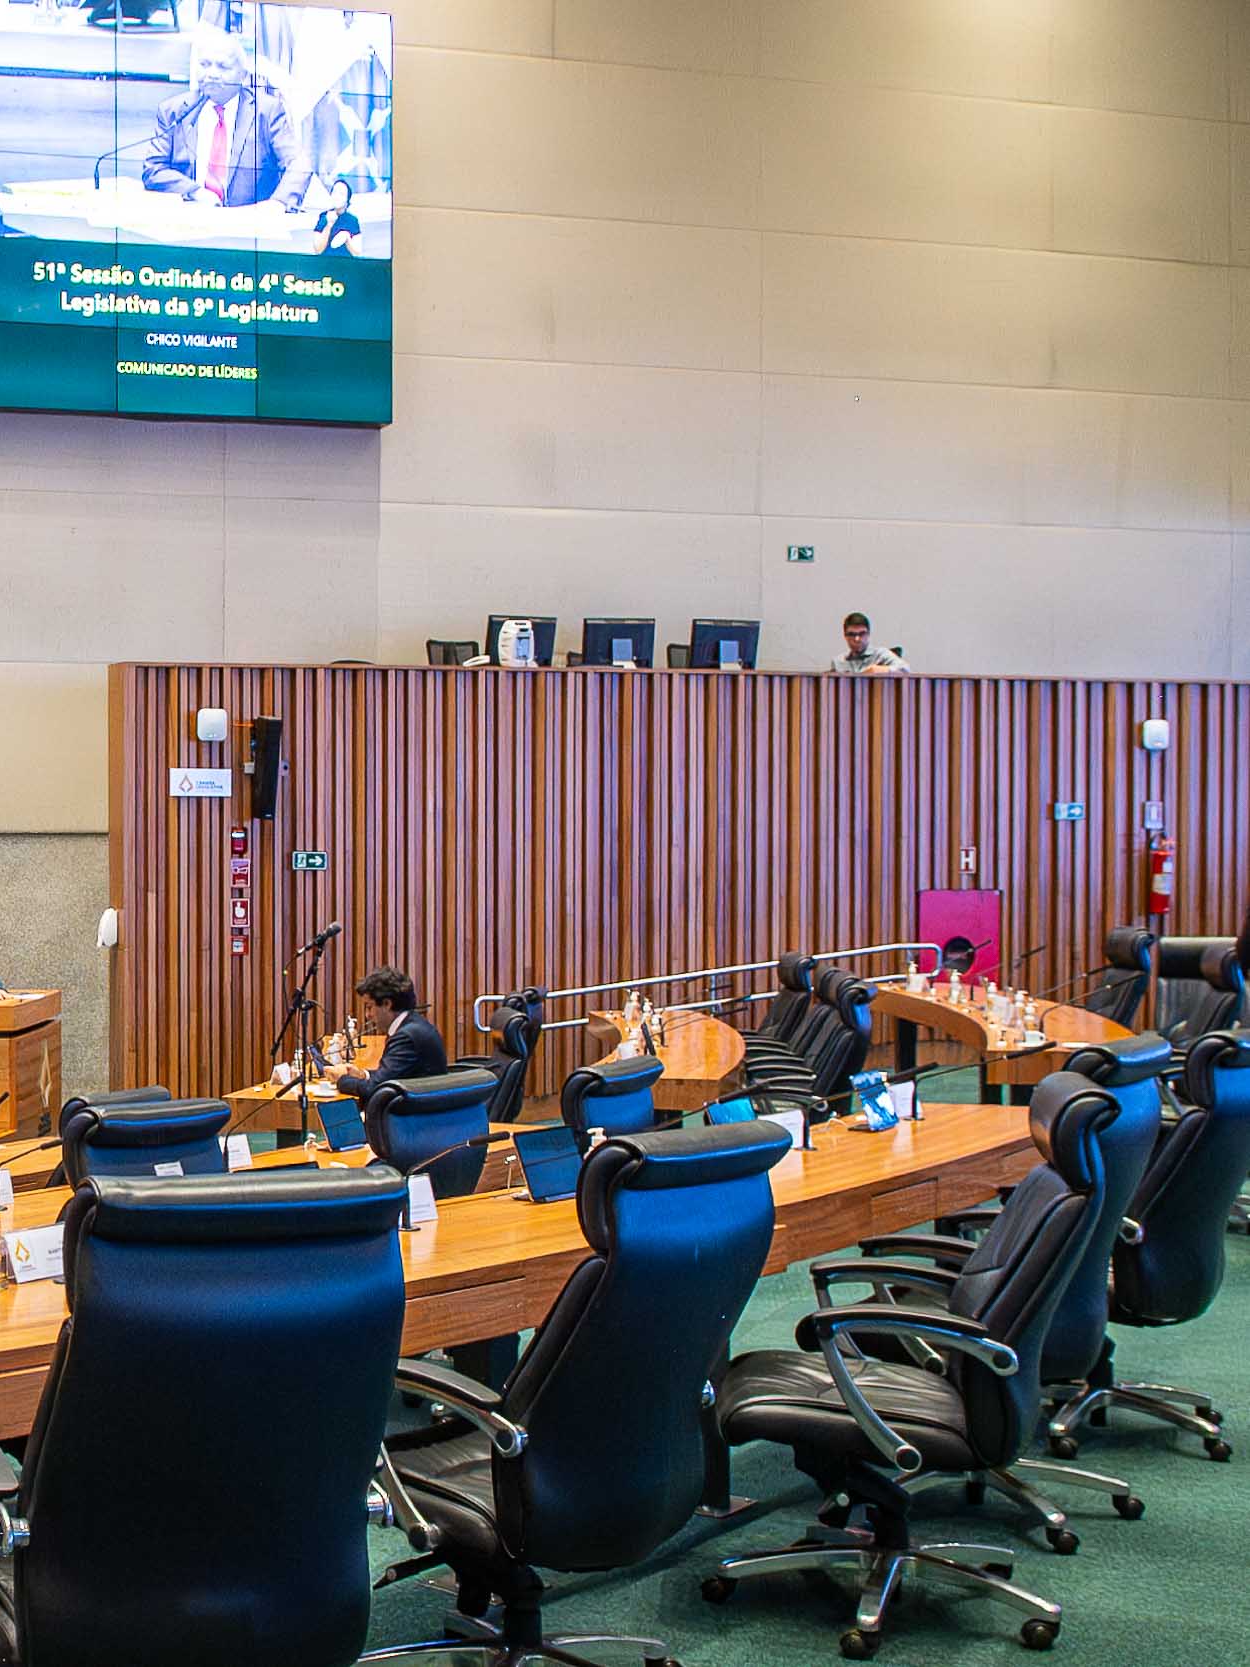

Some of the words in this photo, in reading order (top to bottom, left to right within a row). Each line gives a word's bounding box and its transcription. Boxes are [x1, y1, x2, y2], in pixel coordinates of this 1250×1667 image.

[33, 262, 66, 282] 51ª
[70, 264, 135, 285] Sessão
[139, 266, 226, 290] Ordinária
[231, 272, 254, 291] da
[259, 274, 279, 292] 4ª
[283, 275, 345, 297] Sessão
[61, 291, 160, 317] Legislativa
[165, 297, 189, 316] da
[192, 297, 214, 317] 9ª
[219, 299, 319, 324] Legislatura
[146, 333, 181, 347] CHICO
[183, 334, 238, 350] VIGILANTE
[117, 361, 196, 378] COMUNICADO
[198, 364, 213, 378] DE
[215, 363, 258, 380] LÍDERES
[961, 850, 974, 870] H
